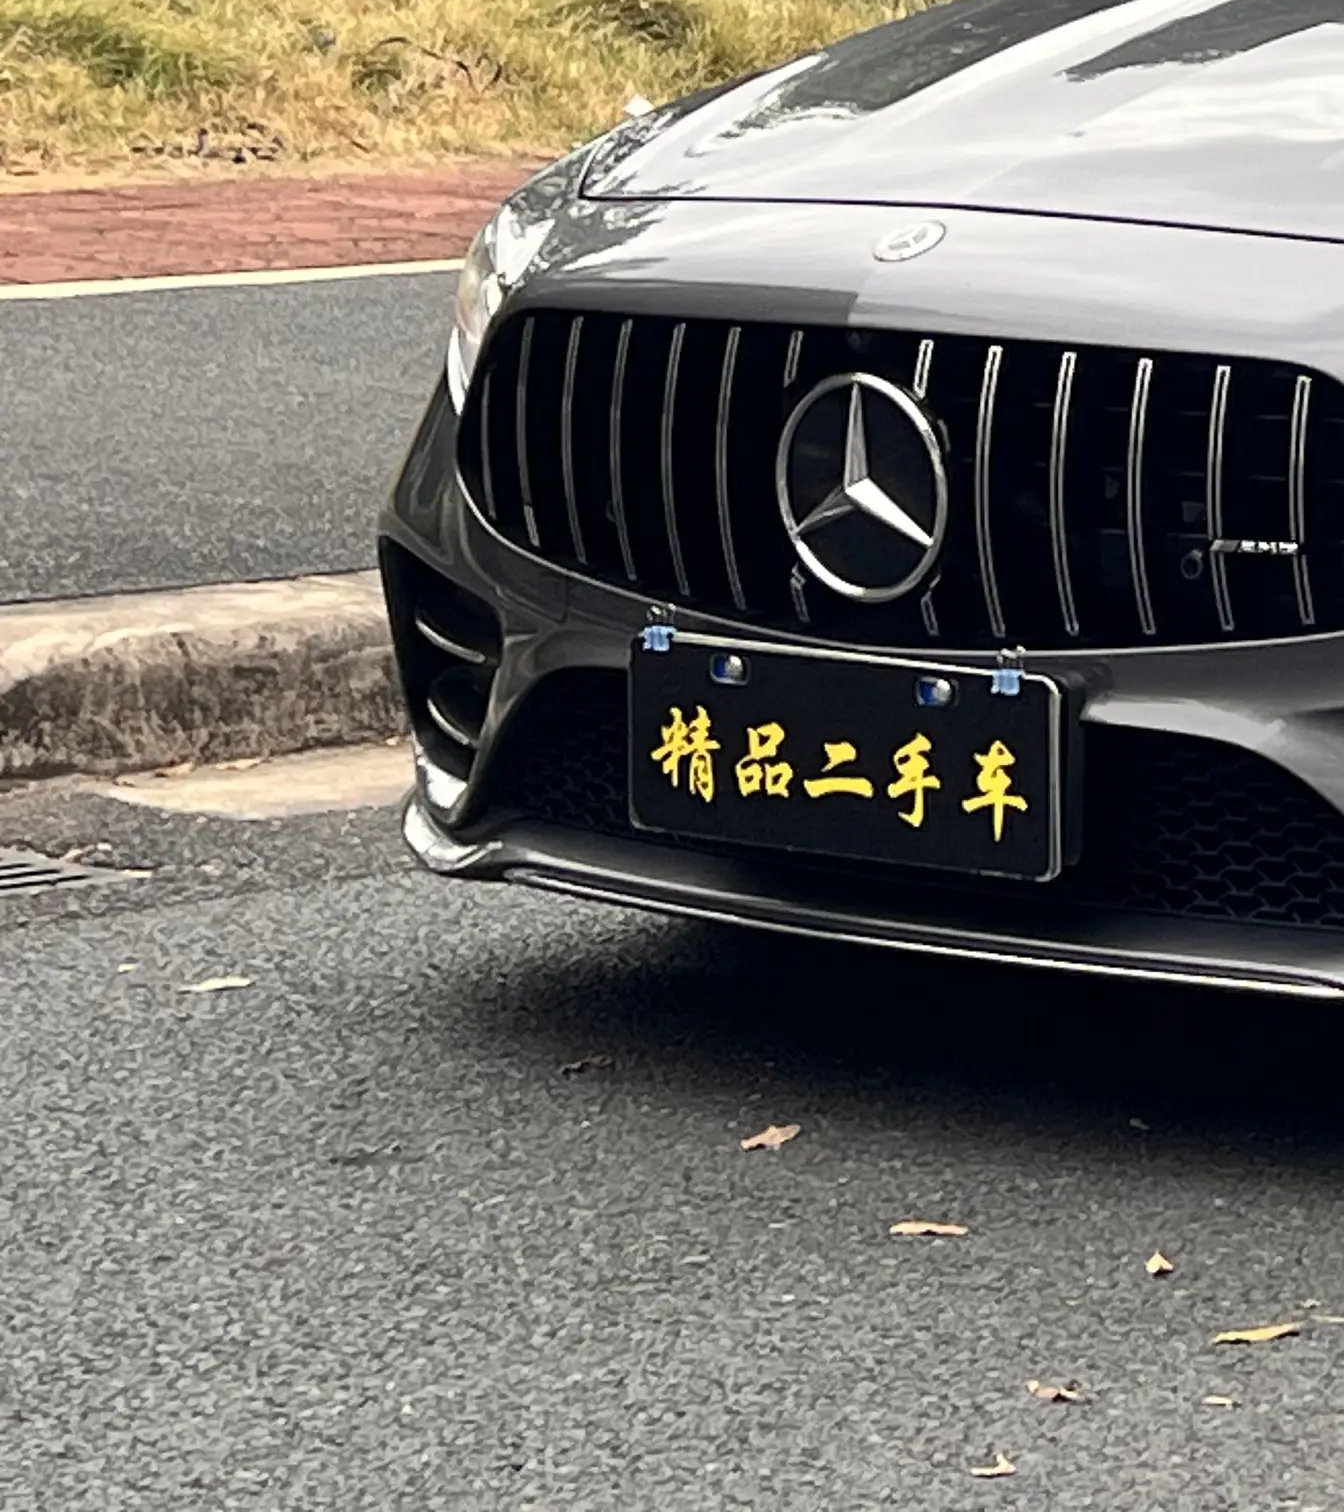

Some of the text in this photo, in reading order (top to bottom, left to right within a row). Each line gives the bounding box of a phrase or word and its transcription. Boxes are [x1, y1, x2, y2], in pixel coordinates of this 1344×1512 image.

[650, 706, 1028, 842] 精品二手车
